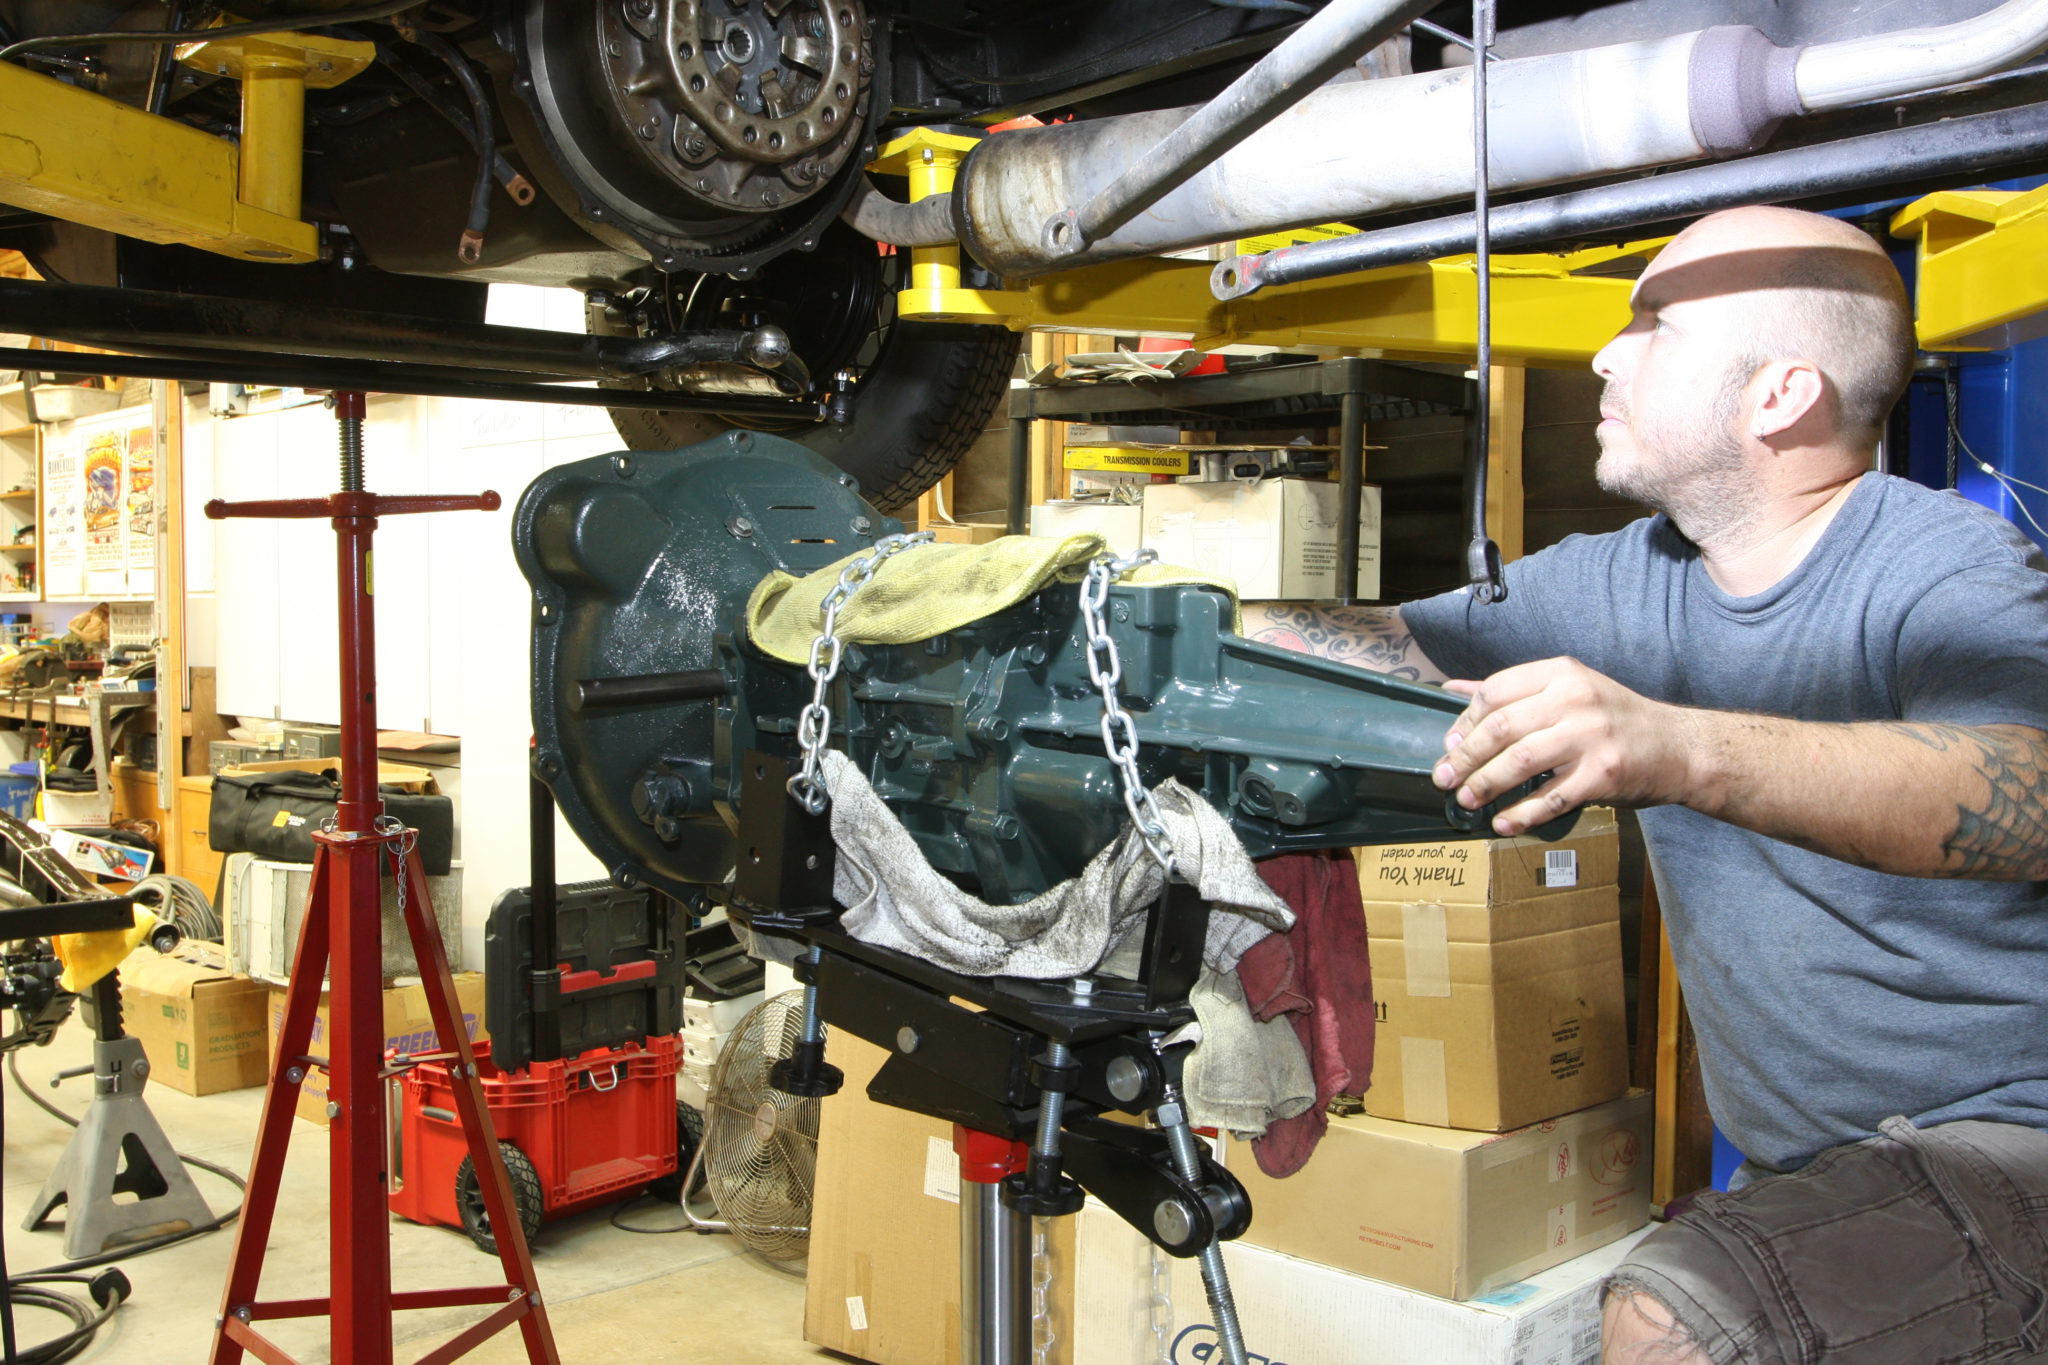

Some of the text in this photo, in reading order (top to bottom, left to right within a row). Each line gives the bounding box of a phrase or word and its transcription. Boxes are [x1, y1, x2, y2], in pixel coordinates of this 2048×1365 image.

[1103, 456, 1182, 467] TRANSMISSION COOLERS
[1380, 845, 1468, 862] for your order!
[1379, 866, 1465, 887] Thank You
[208, 1031, 261, 1043] GRADUATION
[209, 1042, 250, 1054] PRODUCTS
